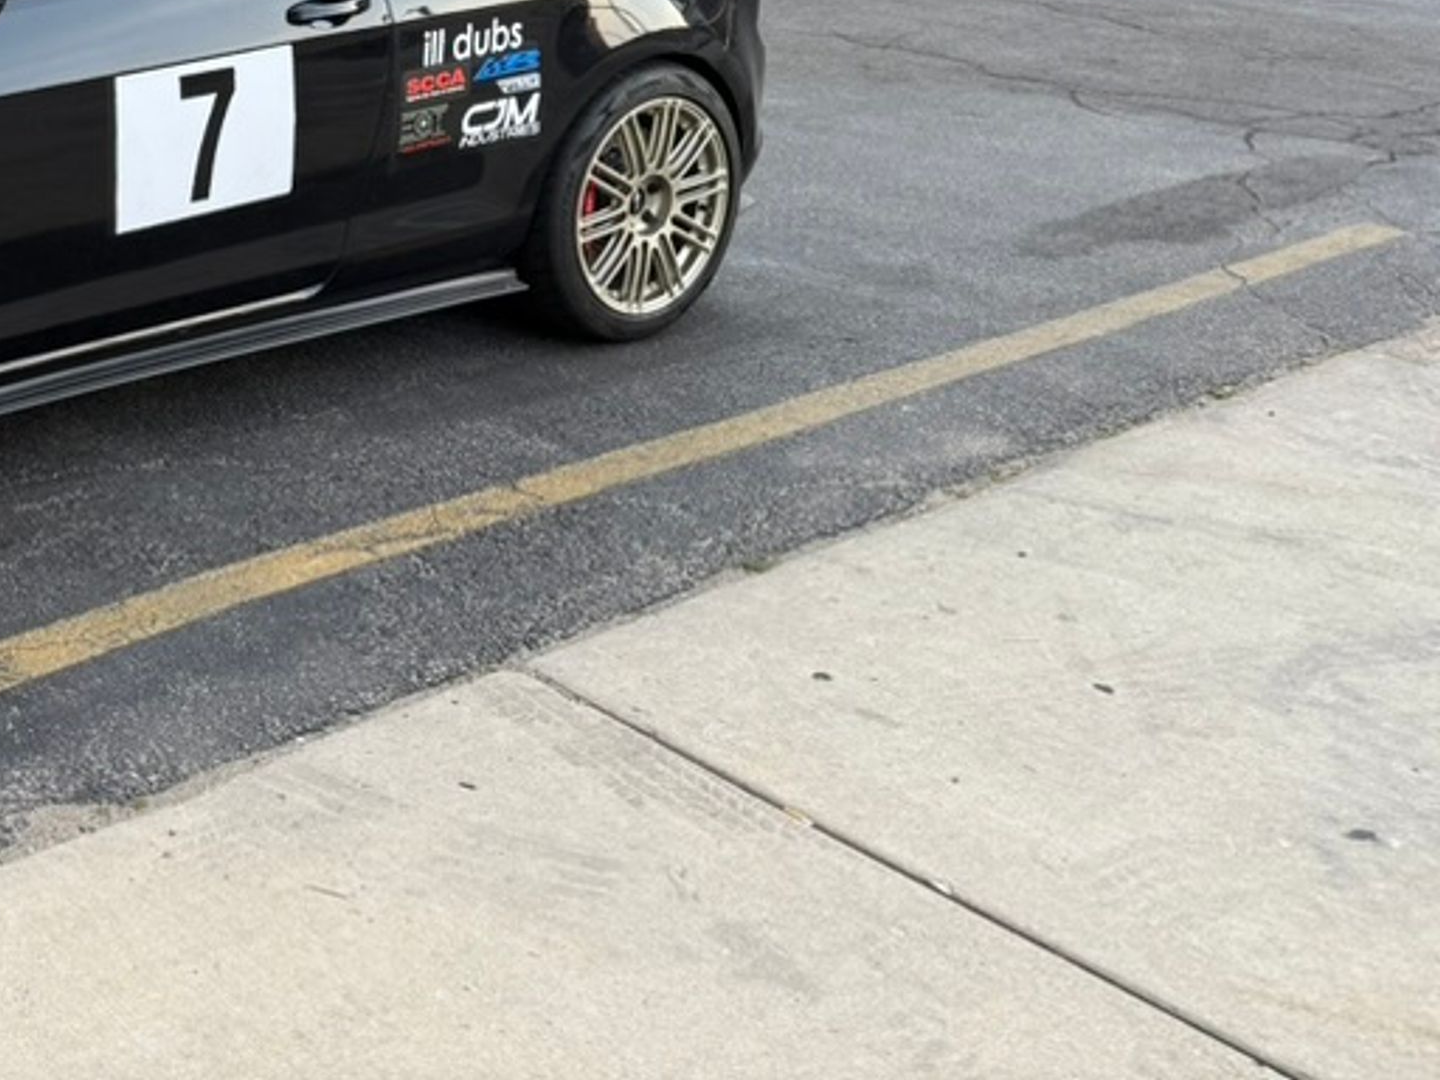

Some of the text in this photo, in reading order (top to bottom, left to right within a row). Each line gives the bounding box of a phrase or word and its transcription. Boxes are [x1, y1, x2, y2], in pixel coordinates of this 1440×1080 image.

[422, 27, 446, 68] ill
[452, 17, 523, 60] dubs
[406, 67, 466, 96] SCCA
[178, 66, 236, 203] 7
